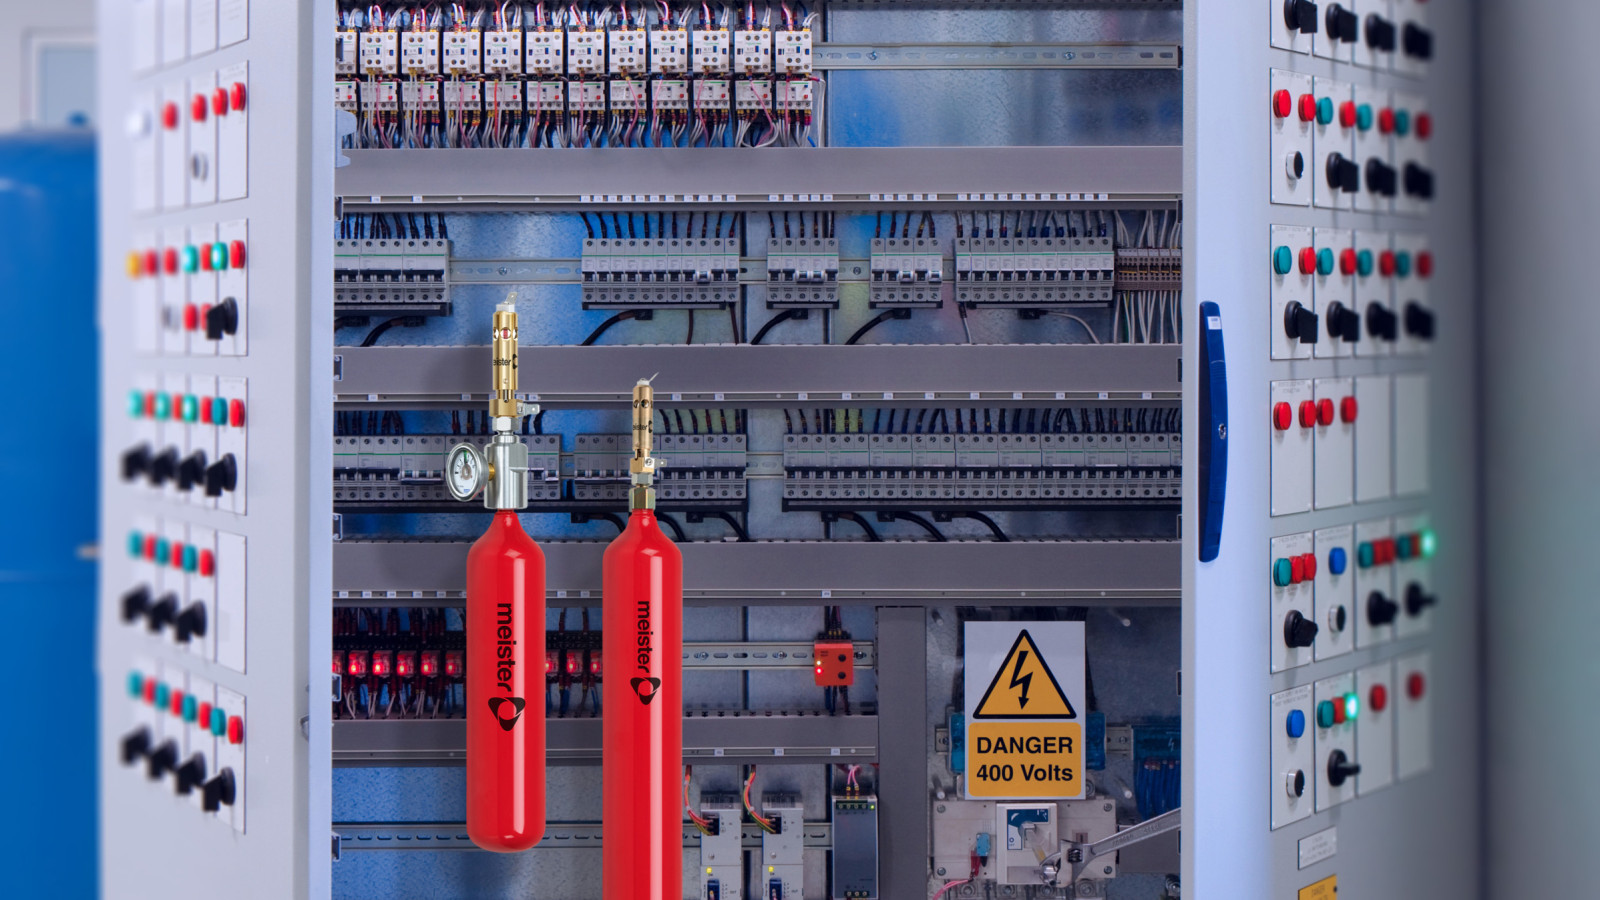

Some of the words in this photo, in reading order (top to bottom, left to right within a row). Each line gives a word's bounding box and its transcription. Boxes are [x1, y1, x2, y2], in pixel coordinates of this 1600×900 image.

[493, 357, 511, 366] eister
[632, 423, 648, 431] eister
[637, 600, 654, 674] meister
[497, 603, 517, 692] meister
[976, 736, 1073, 754] DANGER
[976, 764, 1014, 782] 400
[1020, 764, 1074, 782] Volts
